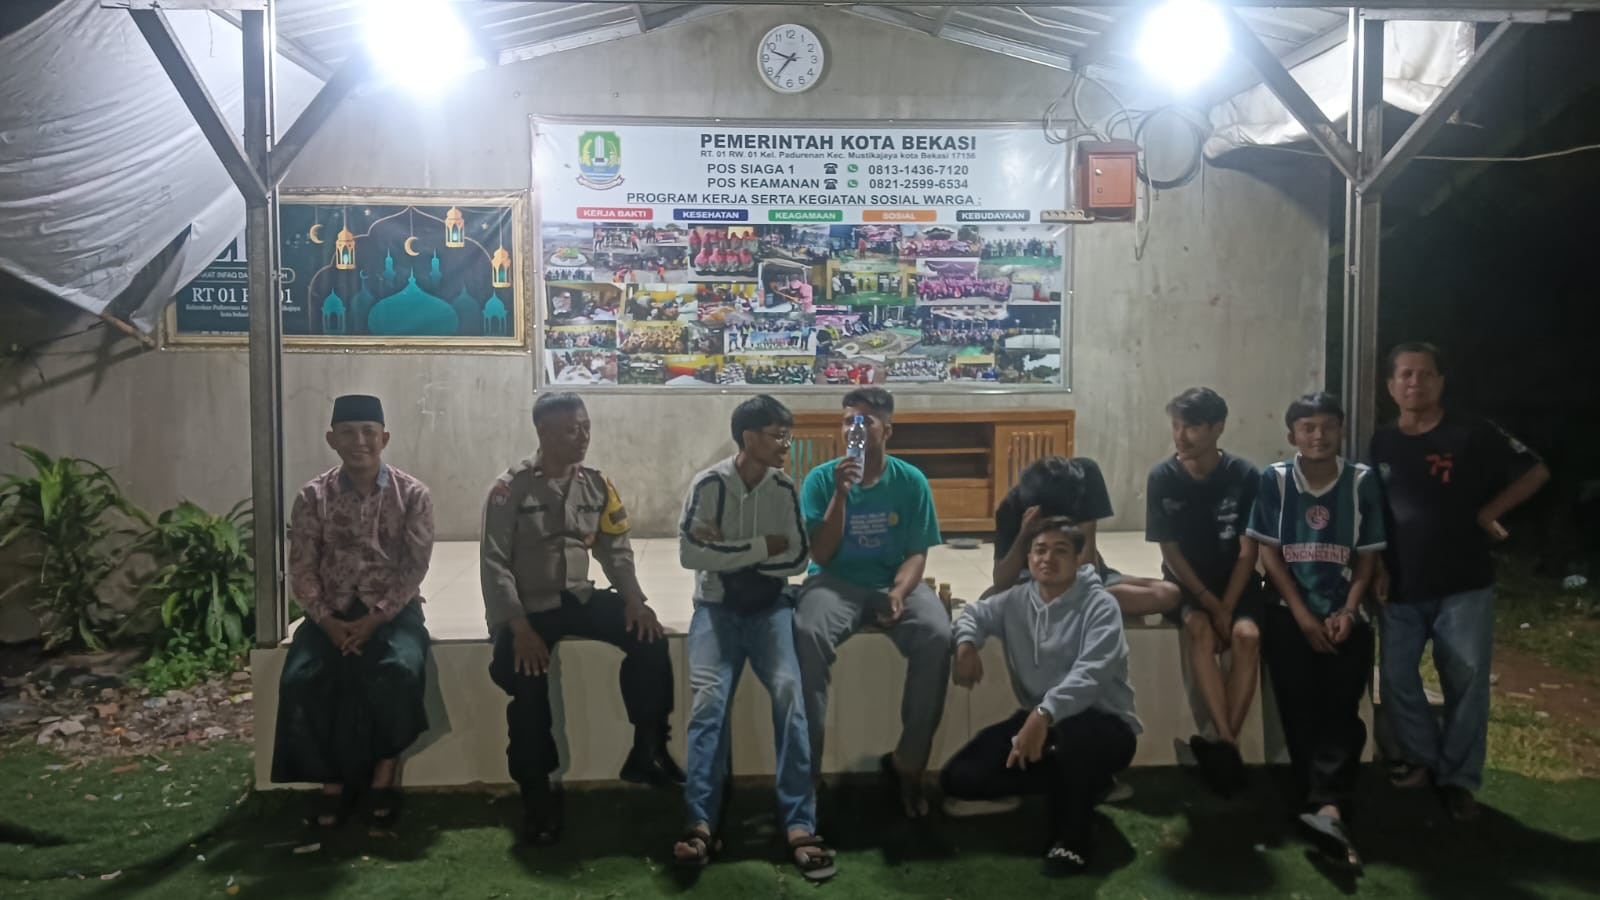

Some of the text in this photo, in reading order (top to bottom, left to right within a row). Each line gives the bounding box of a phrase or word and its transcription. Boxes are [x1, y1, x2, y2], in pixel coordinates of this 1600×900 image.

[700, 133, 976, 151] PEMERINTAH KOTA BEKASI
[700, 150, 715, 158] RT.
[760, 151, 777, 159] Kel.
[779, 151, 825, 159] Padurenan
[848, 152, 898, 161] Mustikajaya
[921, 152, 949, 160] Bekasi
[707, 163, 795, 175] POS SIAGA 1
[868, 165, 970, 176] 0813-1436-7120
[707, 177, 820, 189] POS KEAMANAN
[869, 179, 969, 190] 0821-2599-6534
[627, 193, 698, 203] PROGRAM
[702, 193, 748, 203] KERJA
[751, 194, 796, 204] SERTA
[800, 195, 866, 204] KEGIATAN
[870, 195, 919, 205] SOSIAL
[923, 195, 975, 205] WARGA
[583, 209, 616, 217] KERJA
[682, 211, 740, 219] KESEHATAN
[775, 212, 836, 220] KEAGAMAAN
[961, 212, 1025, 220] KEBUDAYAAN
[192, 287, 215, 302] RT
[218, 287, 237, 303] 01
